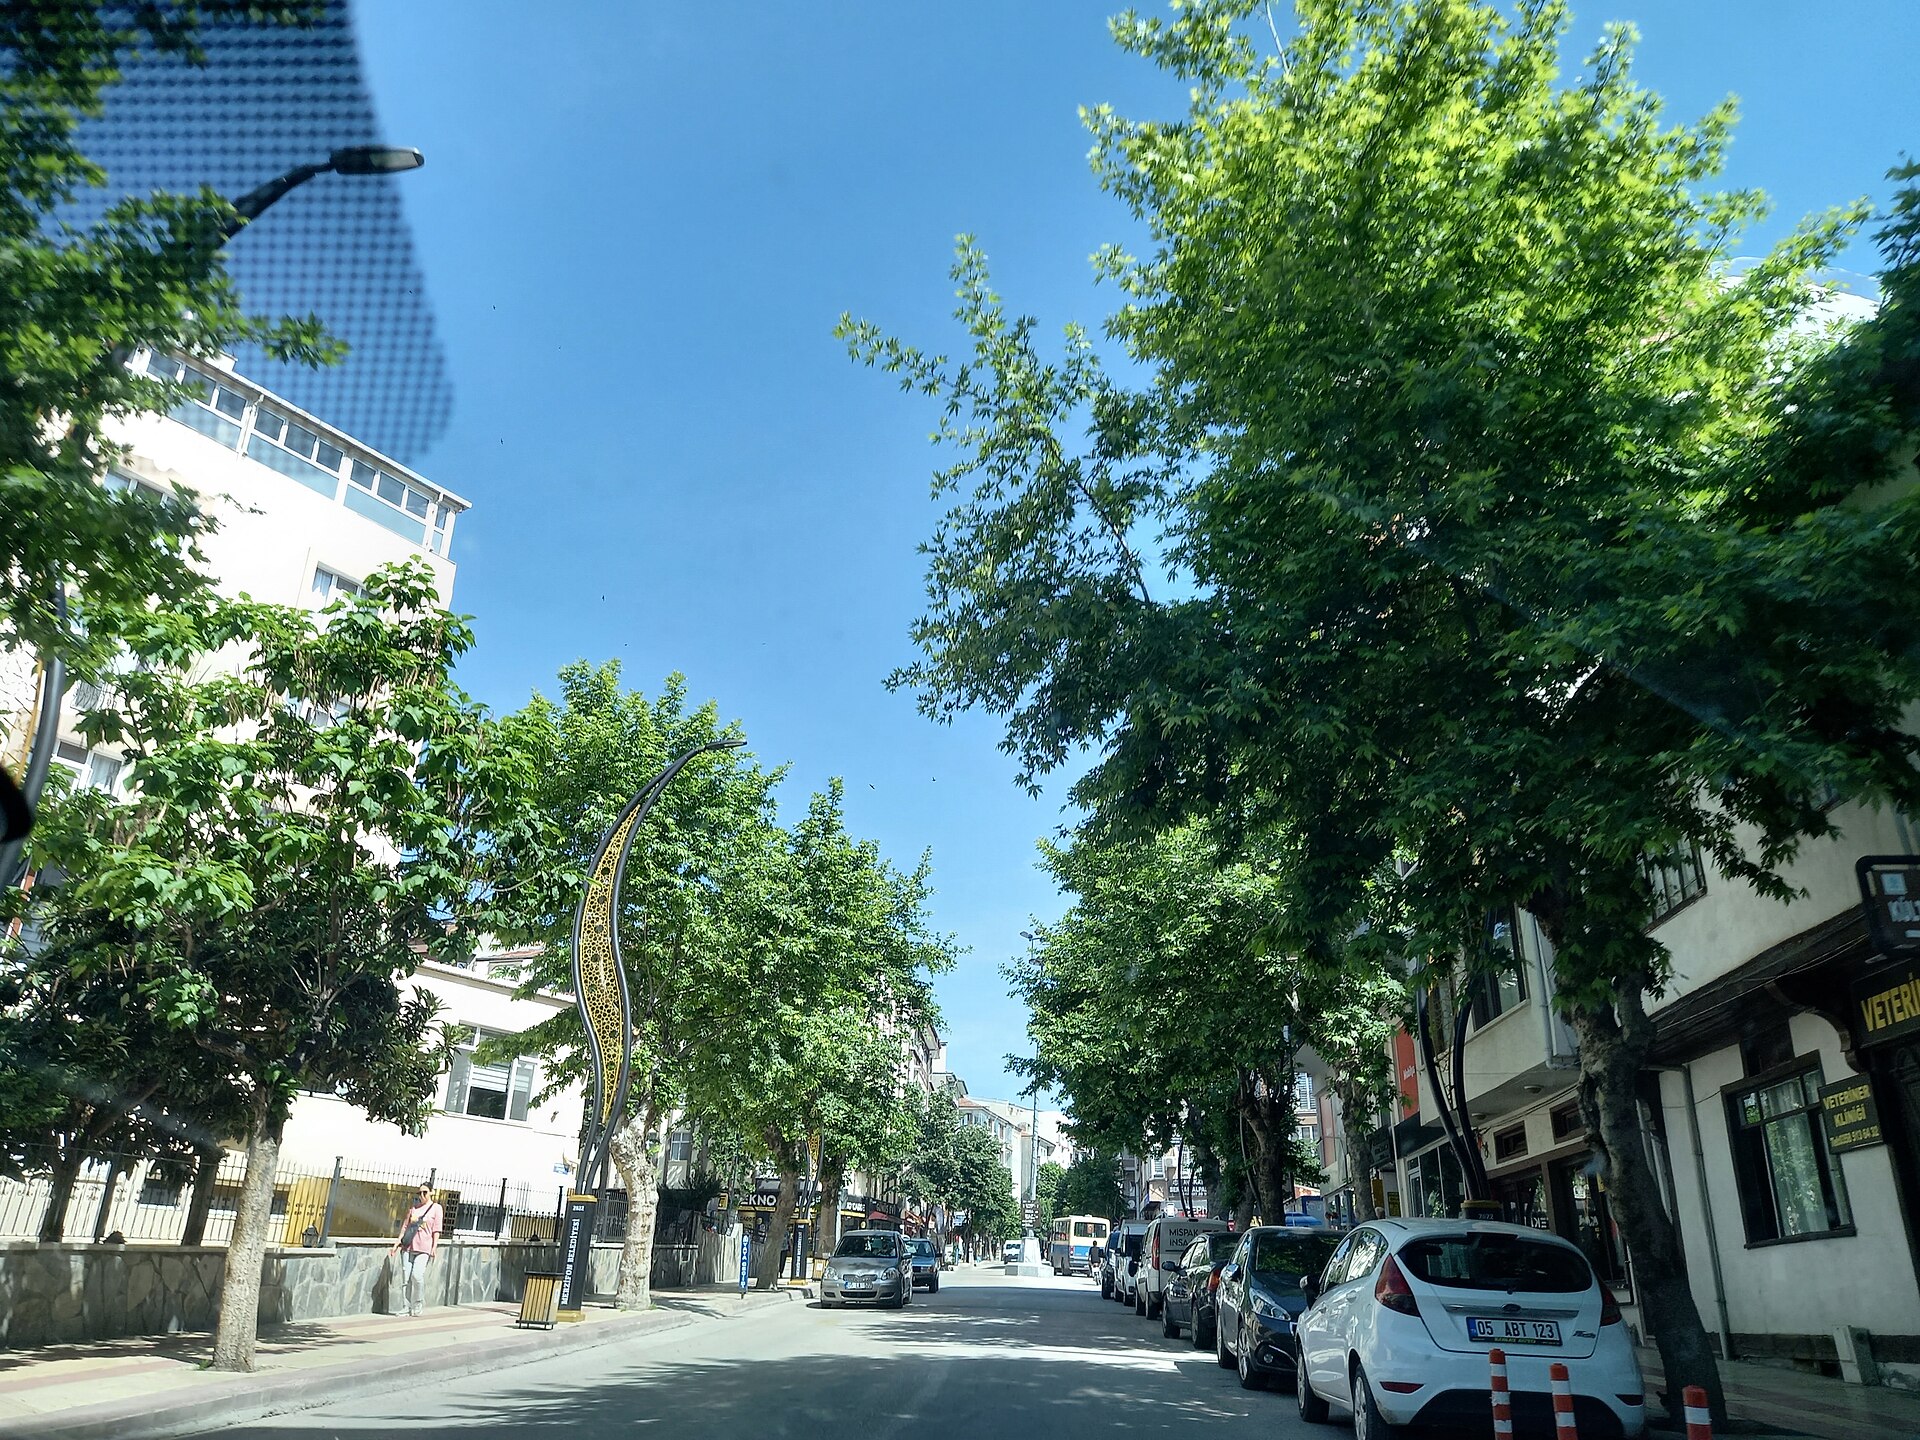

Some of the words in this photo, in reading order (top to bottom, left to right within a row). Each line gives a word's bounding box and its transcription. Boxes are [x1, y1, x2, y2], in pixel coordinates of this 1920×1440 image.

[1823, 1084, 1871, 1110] VETERİNER
[1833, 1103, 1867, 1128] KLİNİĞİ
[740, 1194, 777, 1206] EKNO
[561, 1264, 573, 1305] MERZİFON
[567, 1219, 580, 1263] BELEDİYESİ
[1477, 1320, 1494, 1336] 05
[1505, 1321, 1527, 1338] ABT
[1532, 1323, 1555, 1339] 123
